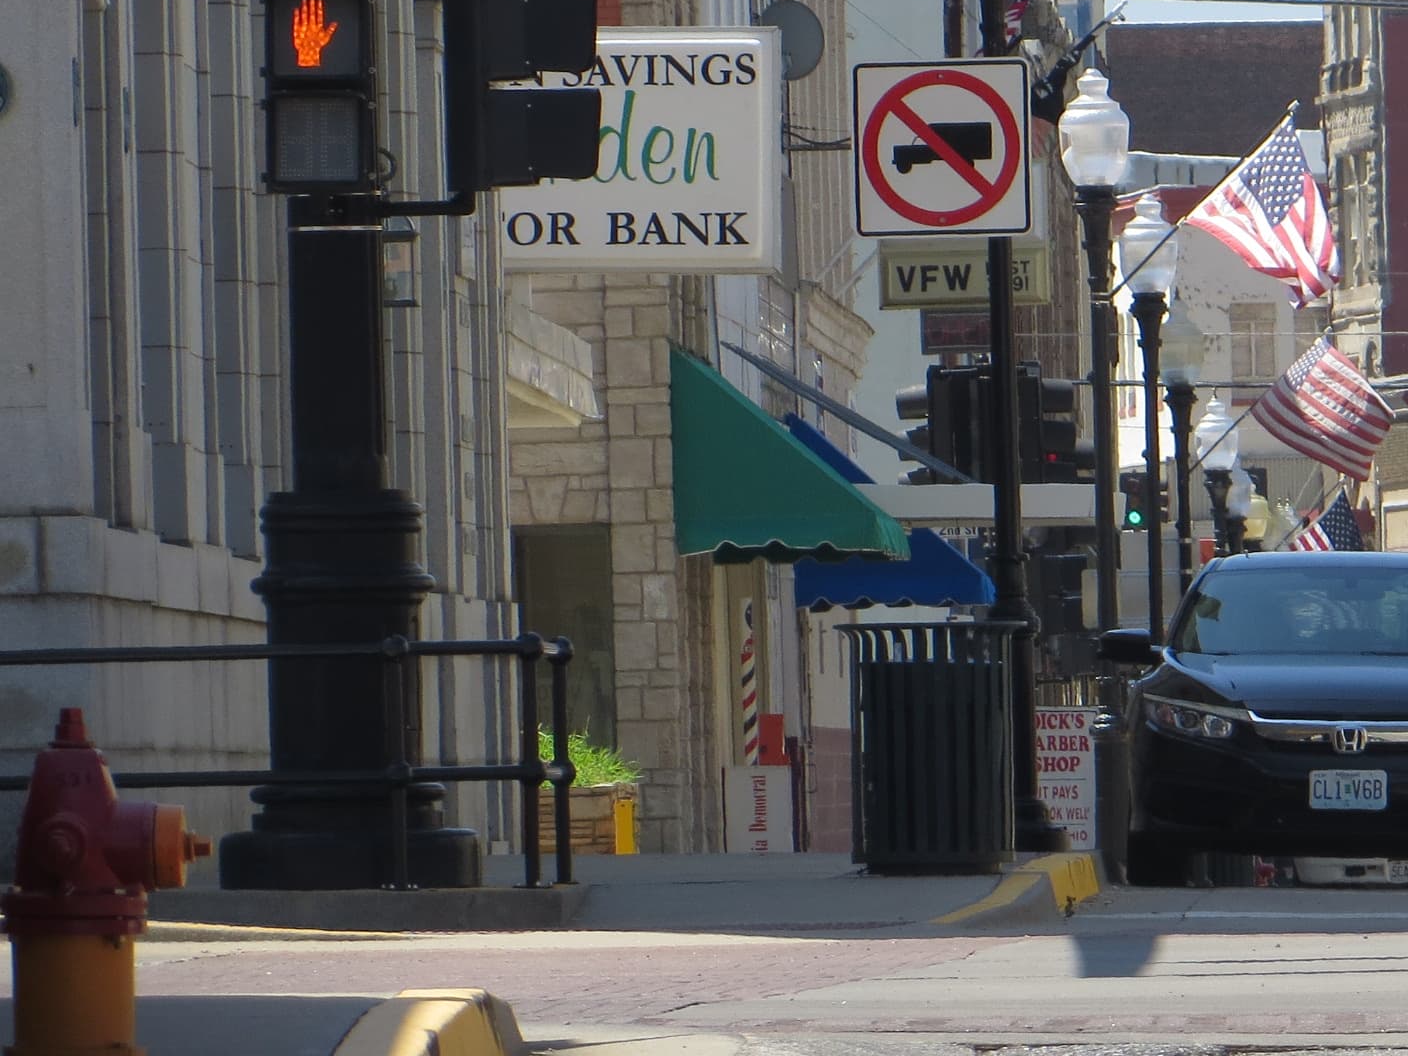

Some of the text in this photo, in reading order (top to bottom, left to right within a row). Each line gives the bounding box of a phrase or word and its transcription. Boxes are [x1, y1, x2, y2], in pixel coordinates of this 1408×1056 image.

[594, 89, 720, 185] den
[502, 211, 751, 247] OR BANK
[896, 263, 972, 293] VFW
[1035, 735, 1090, 752] ARBER
[1052, 784, 1079, 800] PAYS
